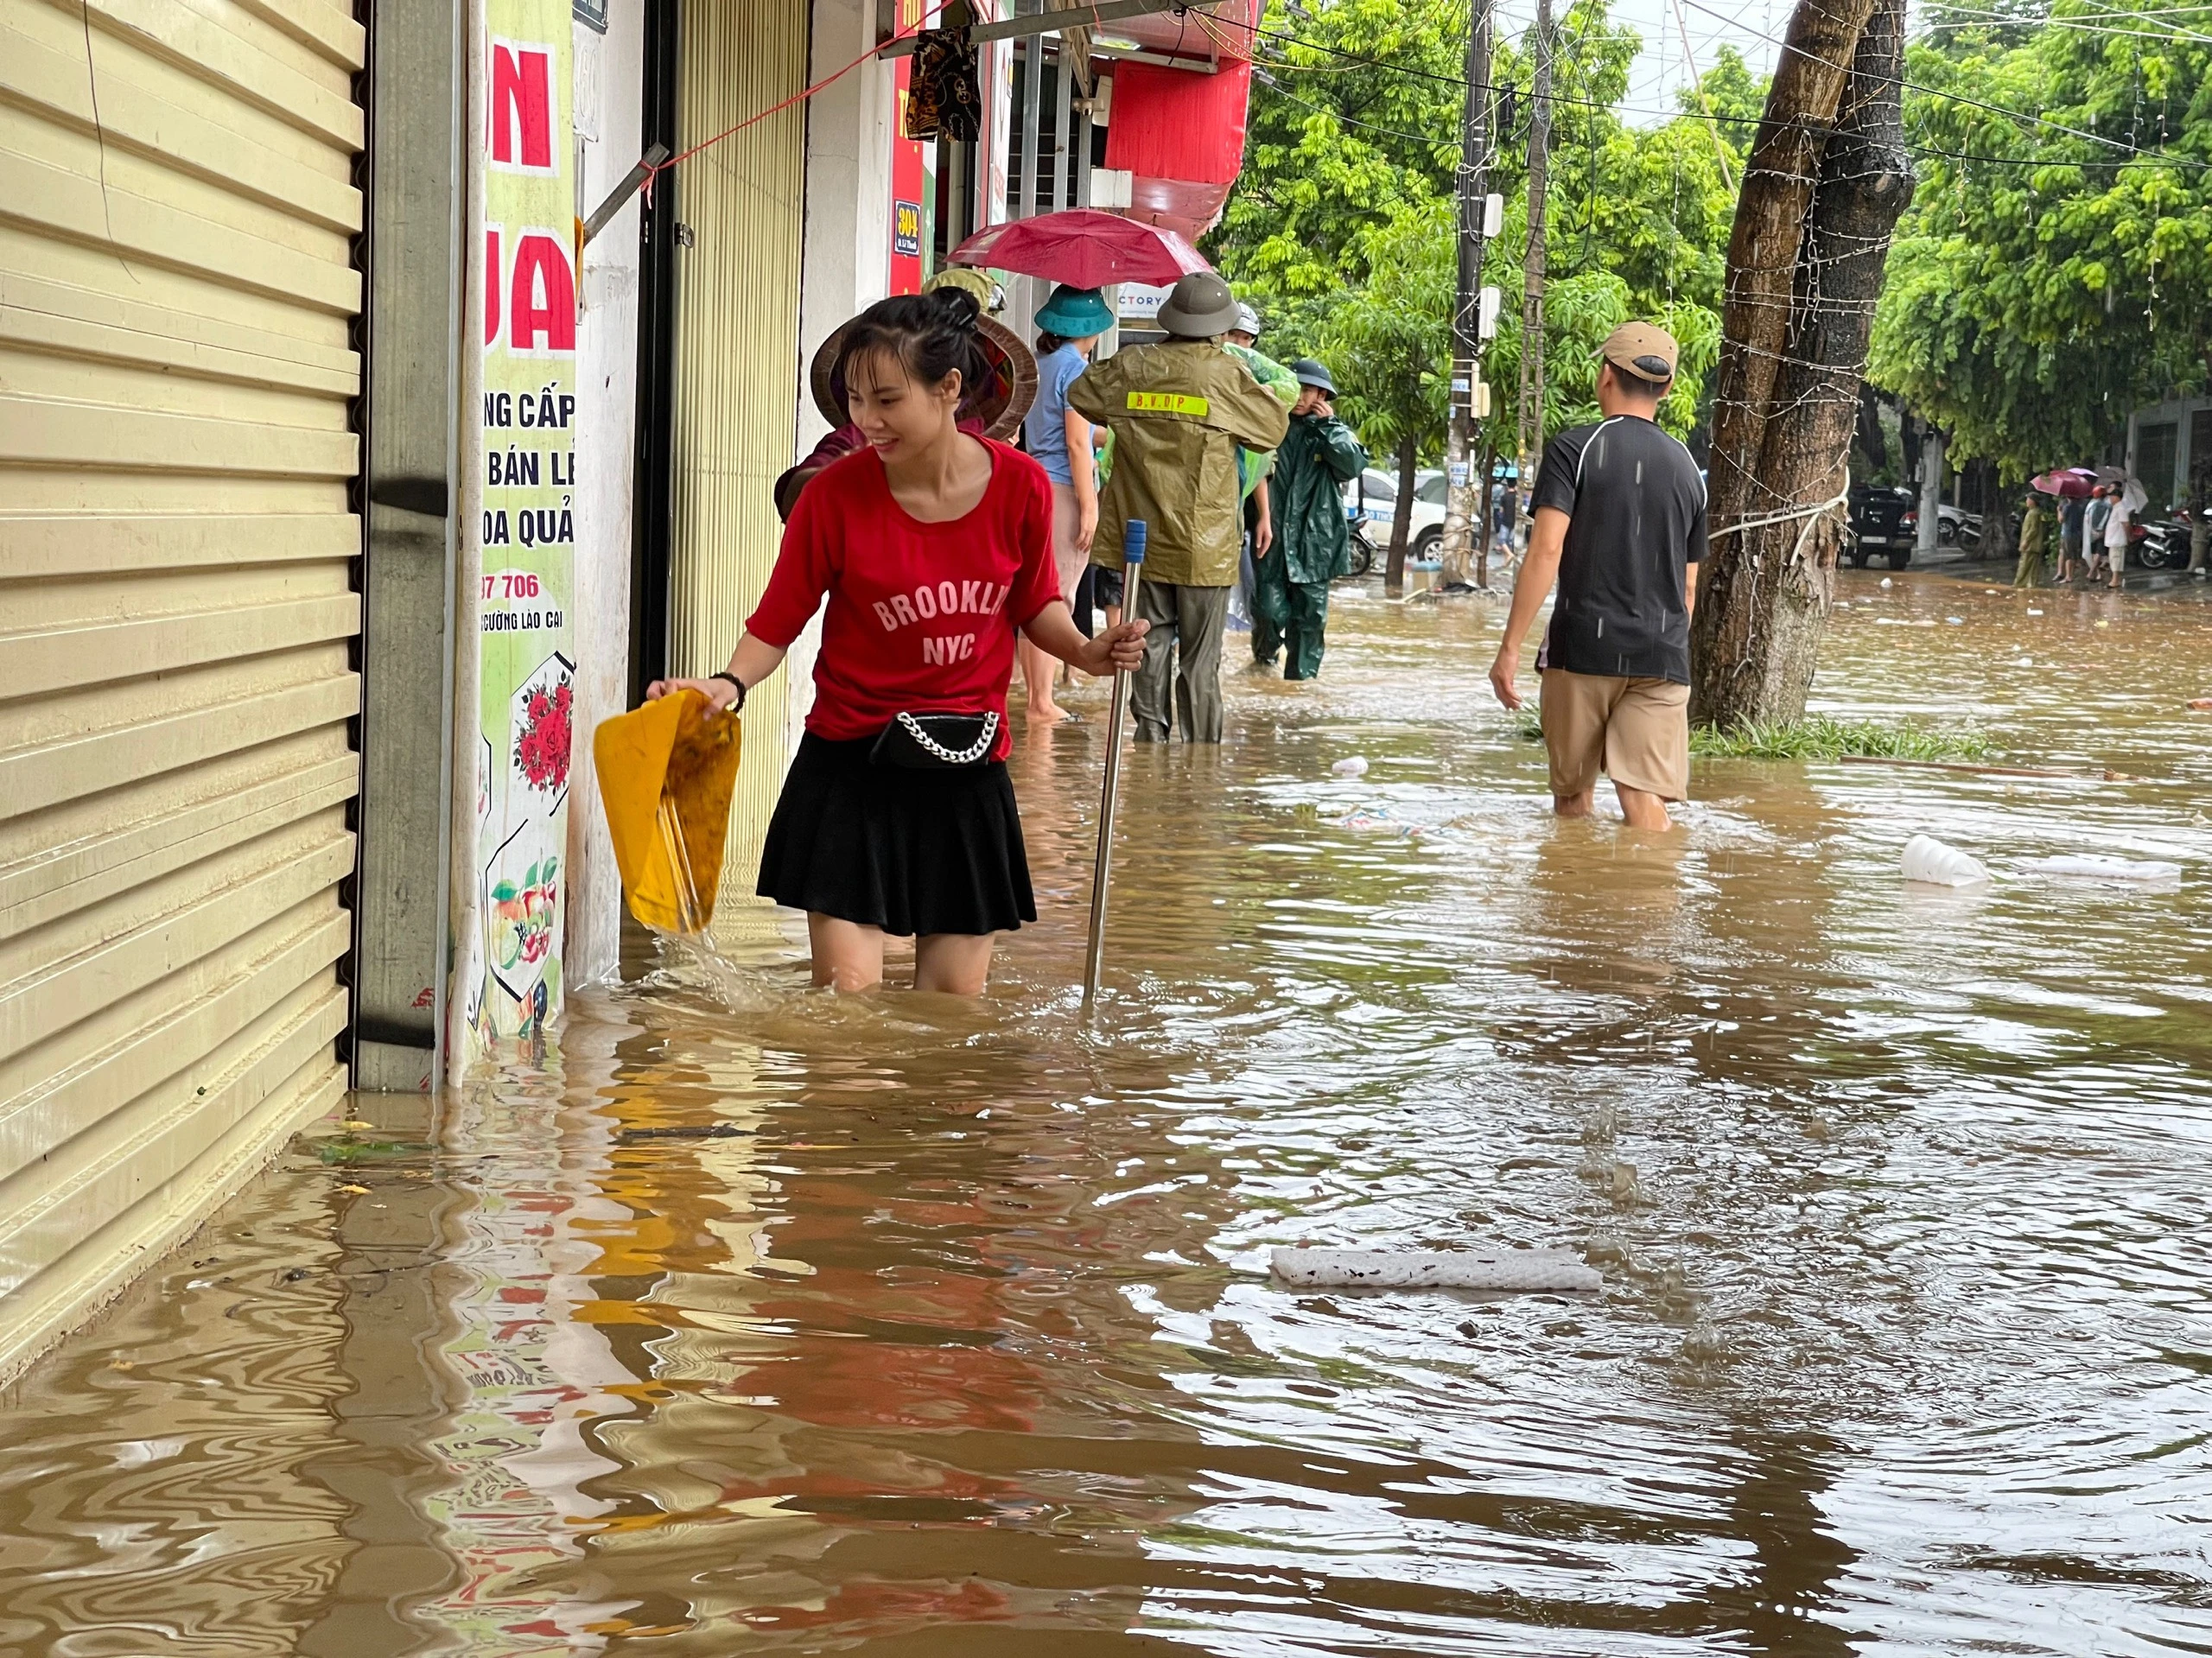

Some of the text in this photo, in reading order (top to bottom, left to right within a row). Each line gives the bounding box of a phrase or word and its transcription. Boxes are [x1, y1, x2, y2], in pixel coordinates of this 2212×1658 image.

[485, 43, 550, 168] N
[518, 382, 575, 428] CẤP
[488, 444, 539, 486] BÁN
[518, 494, 575, 548] QUẢ
[481, 575, 539, 600] 7 706
[521, 608, 541, 629] LÀO
[545, 610, 563, 628] CAI
[923, 632, 976, 666] NYC
